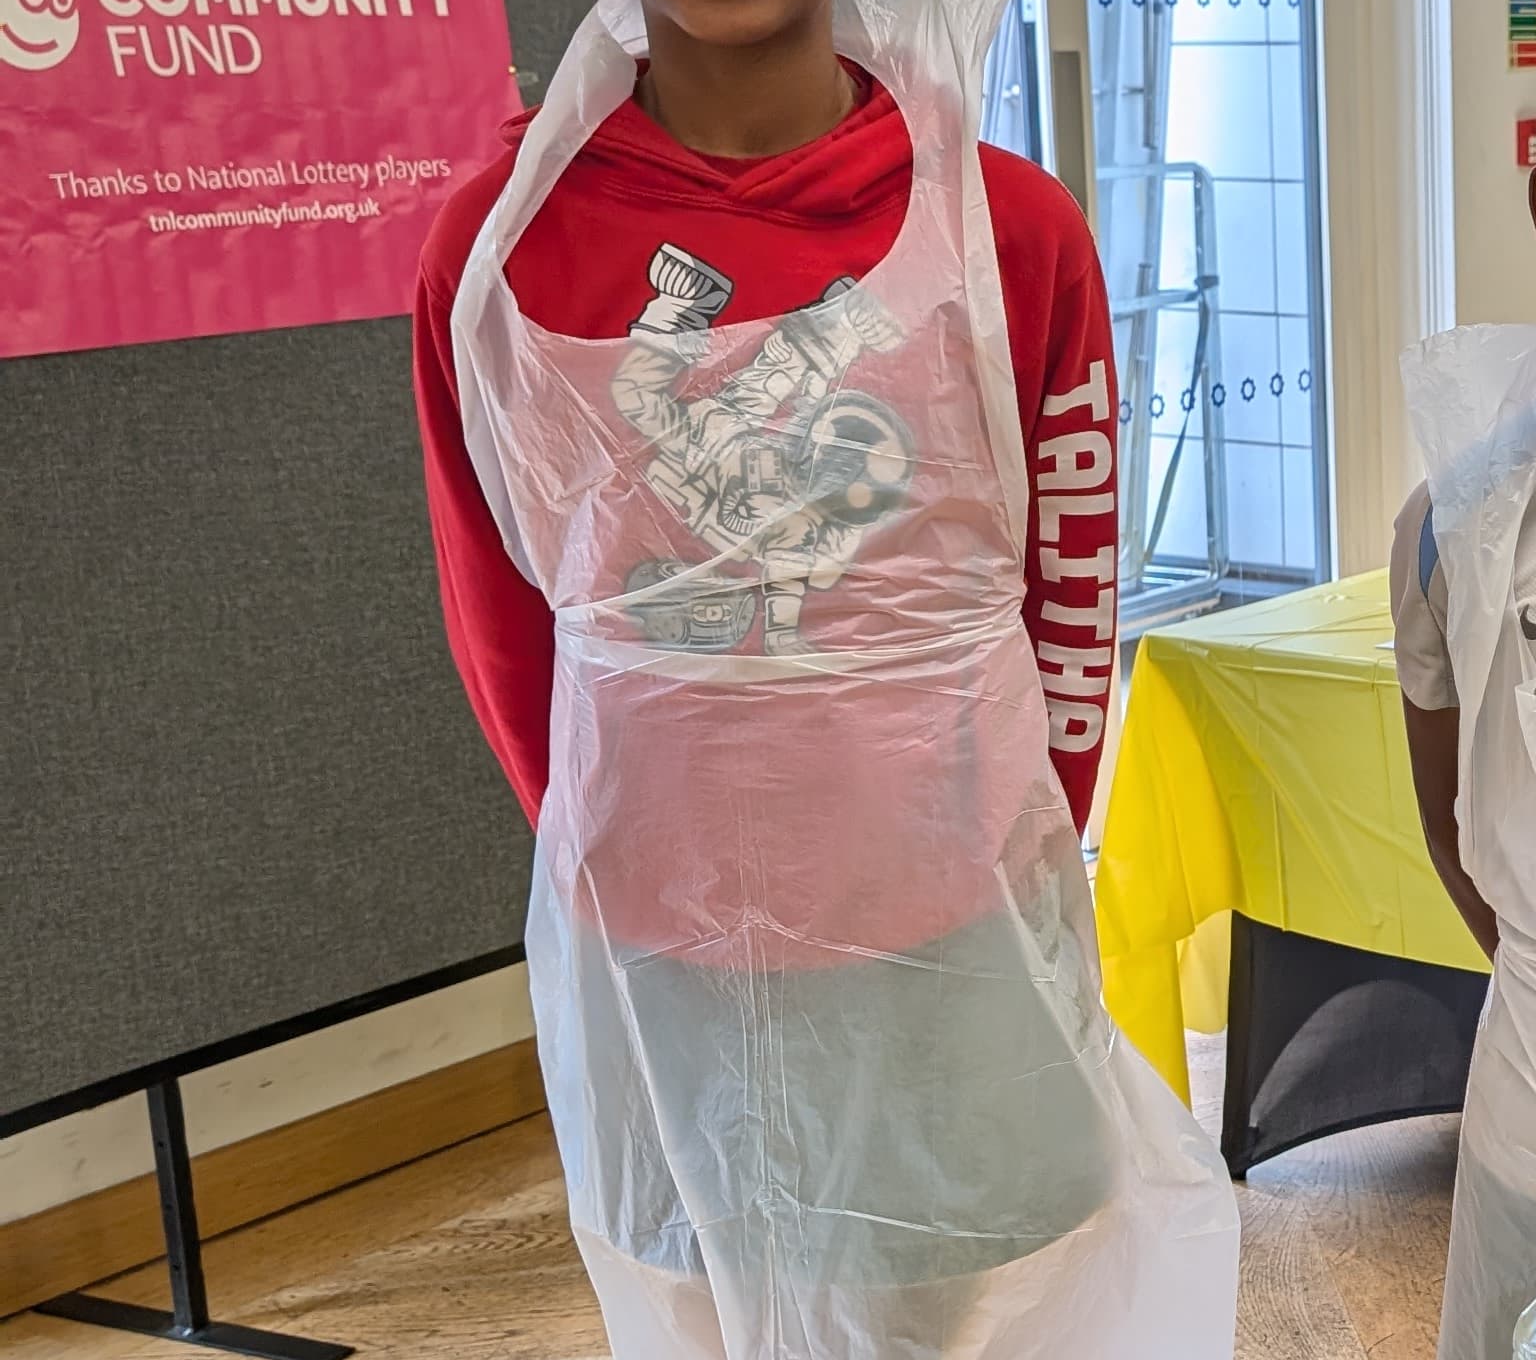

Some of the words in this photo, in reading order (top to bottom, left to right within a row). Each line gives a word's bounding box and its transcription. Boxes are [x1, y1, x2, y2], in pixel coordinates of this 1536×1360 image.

[106, 24, 263, 78] FUND
[49, 168, 148, 200] Thanks
[154, 170, 183, 194] to
[188, 160, 286, 192] National
[291, 160, 370, 189] Lottery
[376, 154, 452, 187] players
[149, 197, 381, 233] tnlcommunityfund.org.uk
